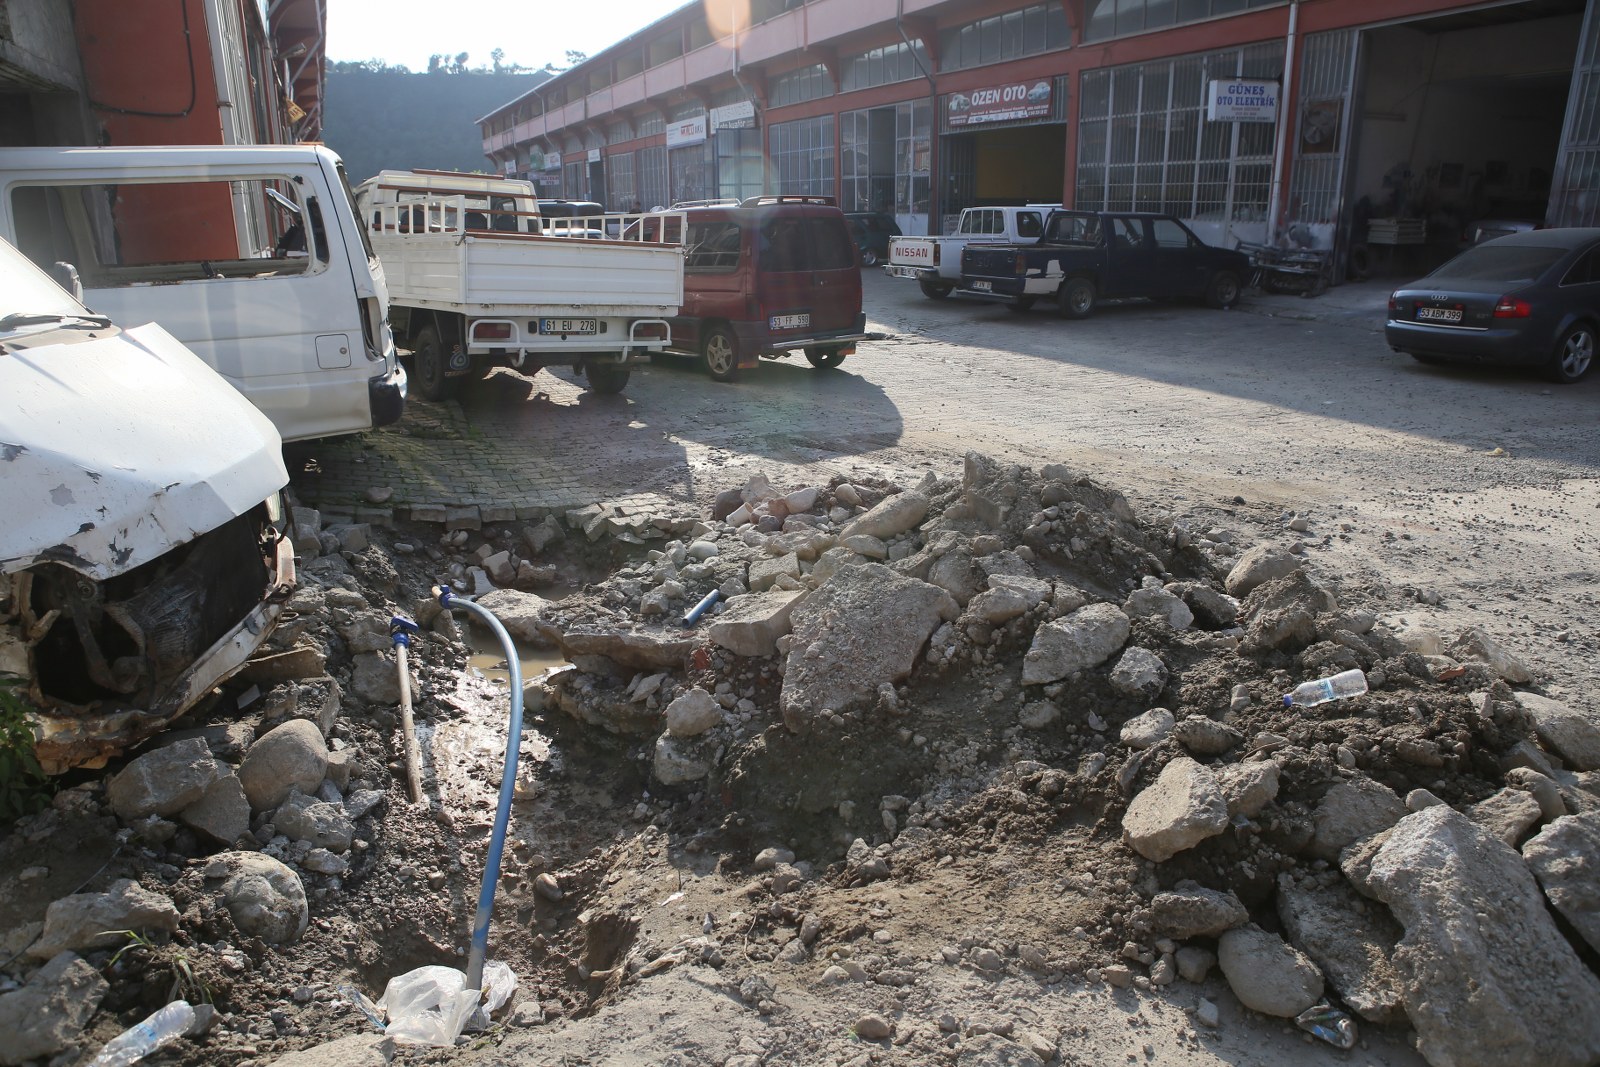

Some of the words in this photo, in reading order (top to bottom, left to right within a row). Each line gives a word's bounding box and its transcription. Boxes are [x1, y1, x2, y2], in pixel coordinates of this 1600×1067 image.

[1003, 84, 1027, 102] OTO
[1228, 83, 1265, 96] GÜNEŞ
[1217, 96, 1233, 105] OTO
[1235, 94, 1275, 108] ELEKTRİK
[895, 247, 928, 257] NISSAN
[785, 315, 793, 325] FF
[1420, 308, 1429, 317] 53
[1431, 309, 1445, 318] ABM
[1446, 310, 1461, 320] 399
[546, 320, 556, 331] 61
[562, 320, 572, 331] EU
[580, 320, 595, 331] 278
